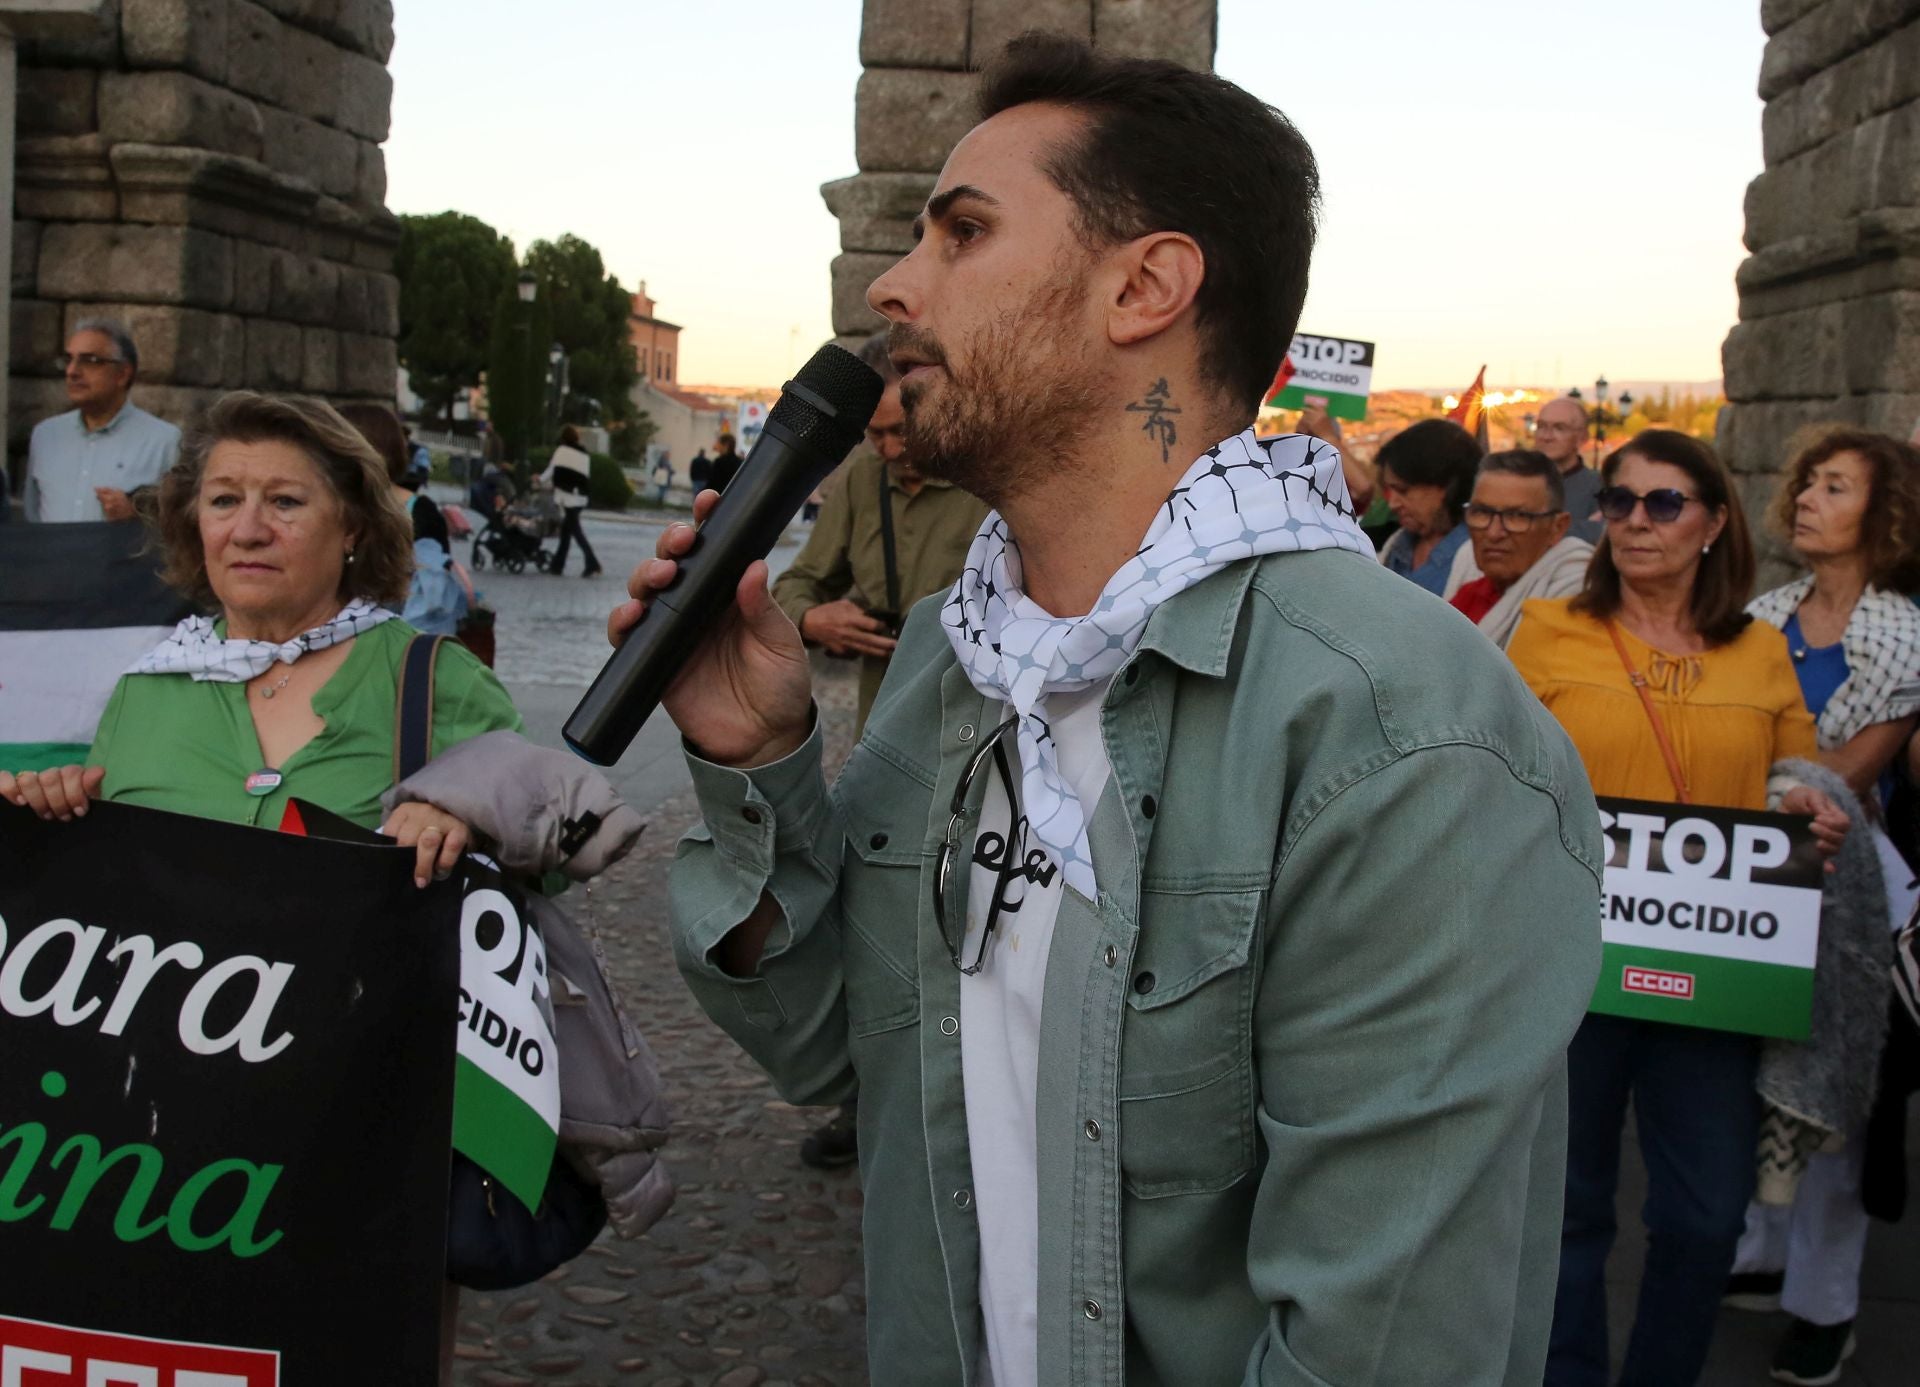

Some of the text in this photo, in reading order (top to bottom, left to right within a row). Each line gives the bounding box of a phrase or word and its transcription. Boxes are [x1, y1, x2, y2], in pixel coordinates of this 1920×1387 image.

[1289, 336, 1366, 366] STOP
[460, 877, 549, 1000] OP
[0, 914, 296, 1063] ara
[1627, 971, 1690, 994] CCOO
